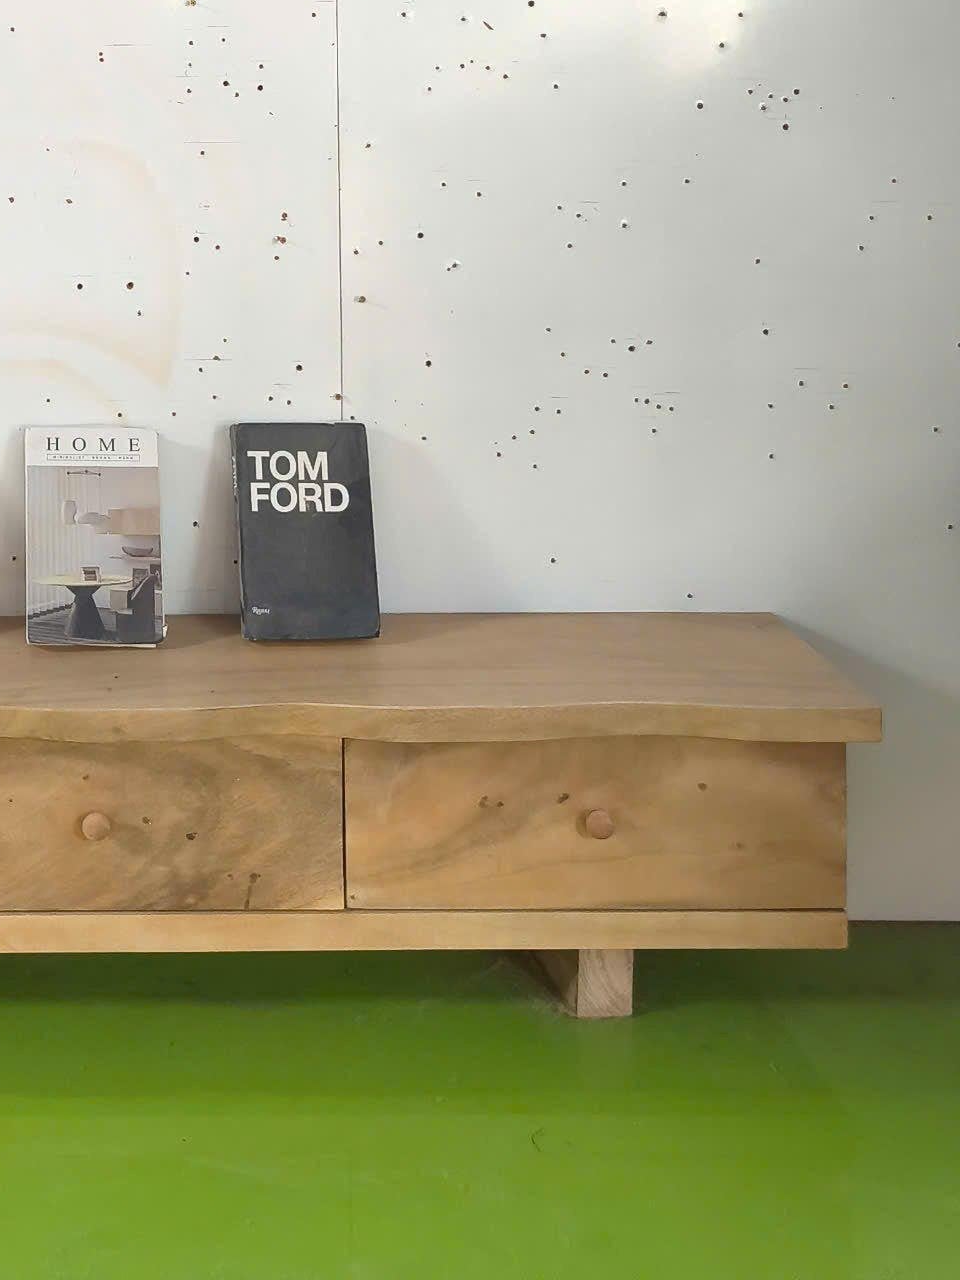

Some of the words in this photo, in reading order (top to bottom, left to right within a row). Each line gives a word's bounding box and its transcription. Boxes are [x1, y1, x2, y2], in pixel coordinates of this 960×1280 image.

[46, 437, 141, 452] HOME
[247, 450, 330, 481] TOM
[250, 482, 350, 513] FORD
